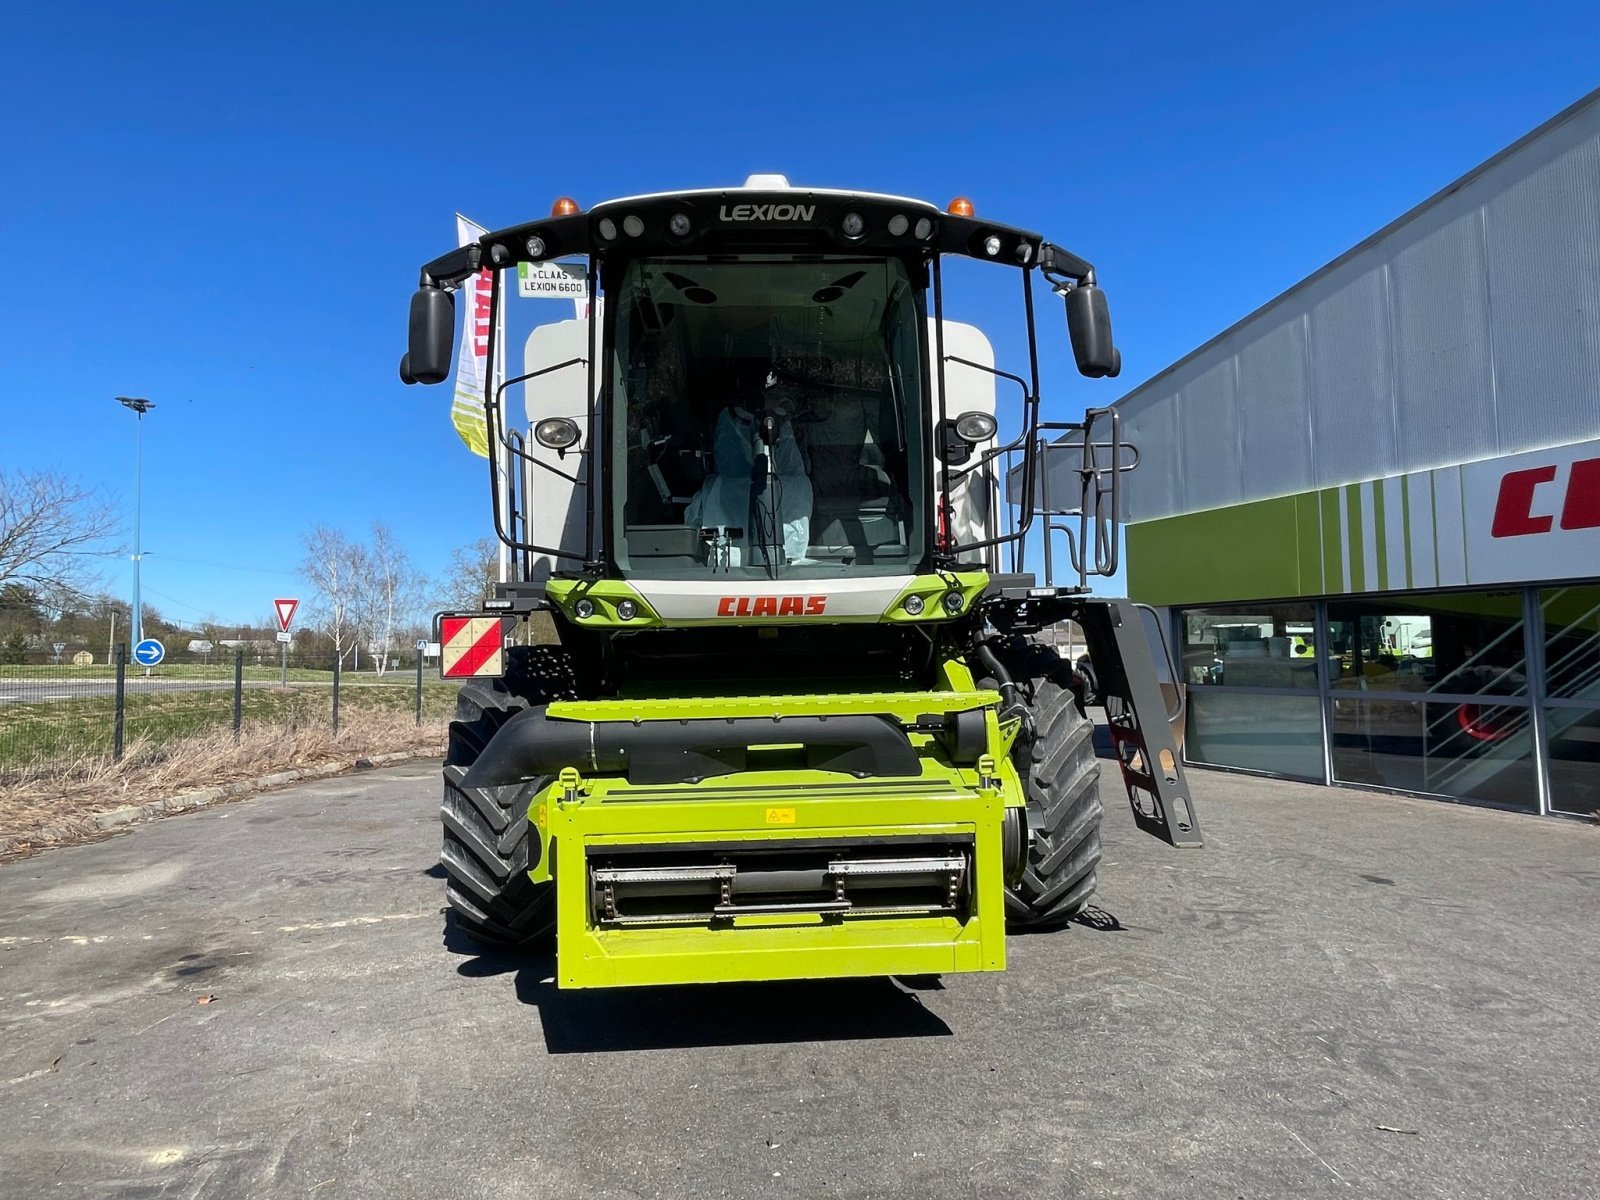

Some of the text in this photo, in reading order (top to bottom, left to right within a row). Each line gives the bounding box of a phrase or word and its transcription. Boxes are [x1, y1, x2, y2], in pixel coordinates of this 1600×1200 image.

[719, 204, 816, 221] LEXION
[538, 270, 568, 280] CLAAS
[524, 281, 582, 292] LEXION 6600
[717, 596, 827, 616] CLAAS
